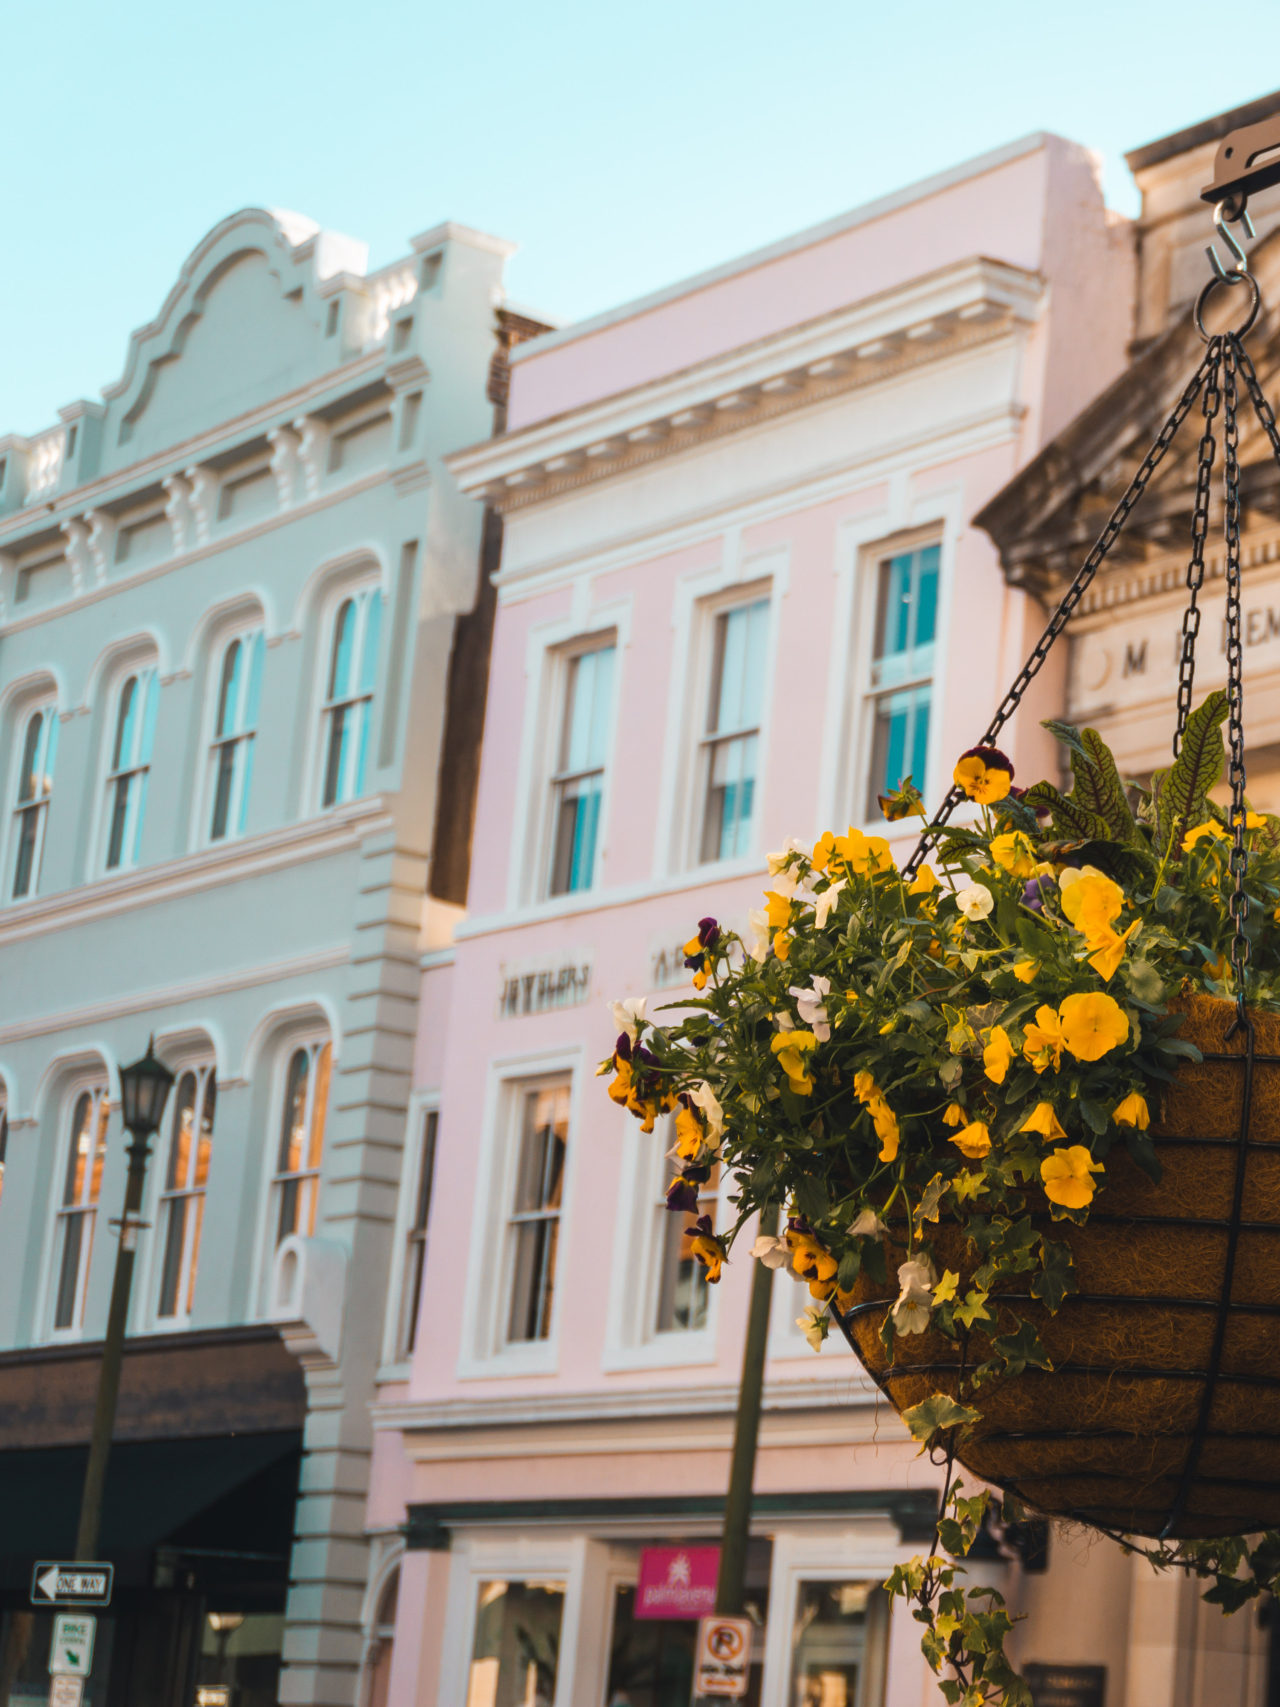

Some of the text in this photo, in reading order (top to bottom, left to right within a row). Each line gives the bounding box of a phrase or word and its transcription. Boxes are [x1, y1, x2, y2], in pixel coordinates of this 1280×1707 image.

[1122, 638, 1149, 678] M
[56, 1574, 104, 1592] ONE WAY
